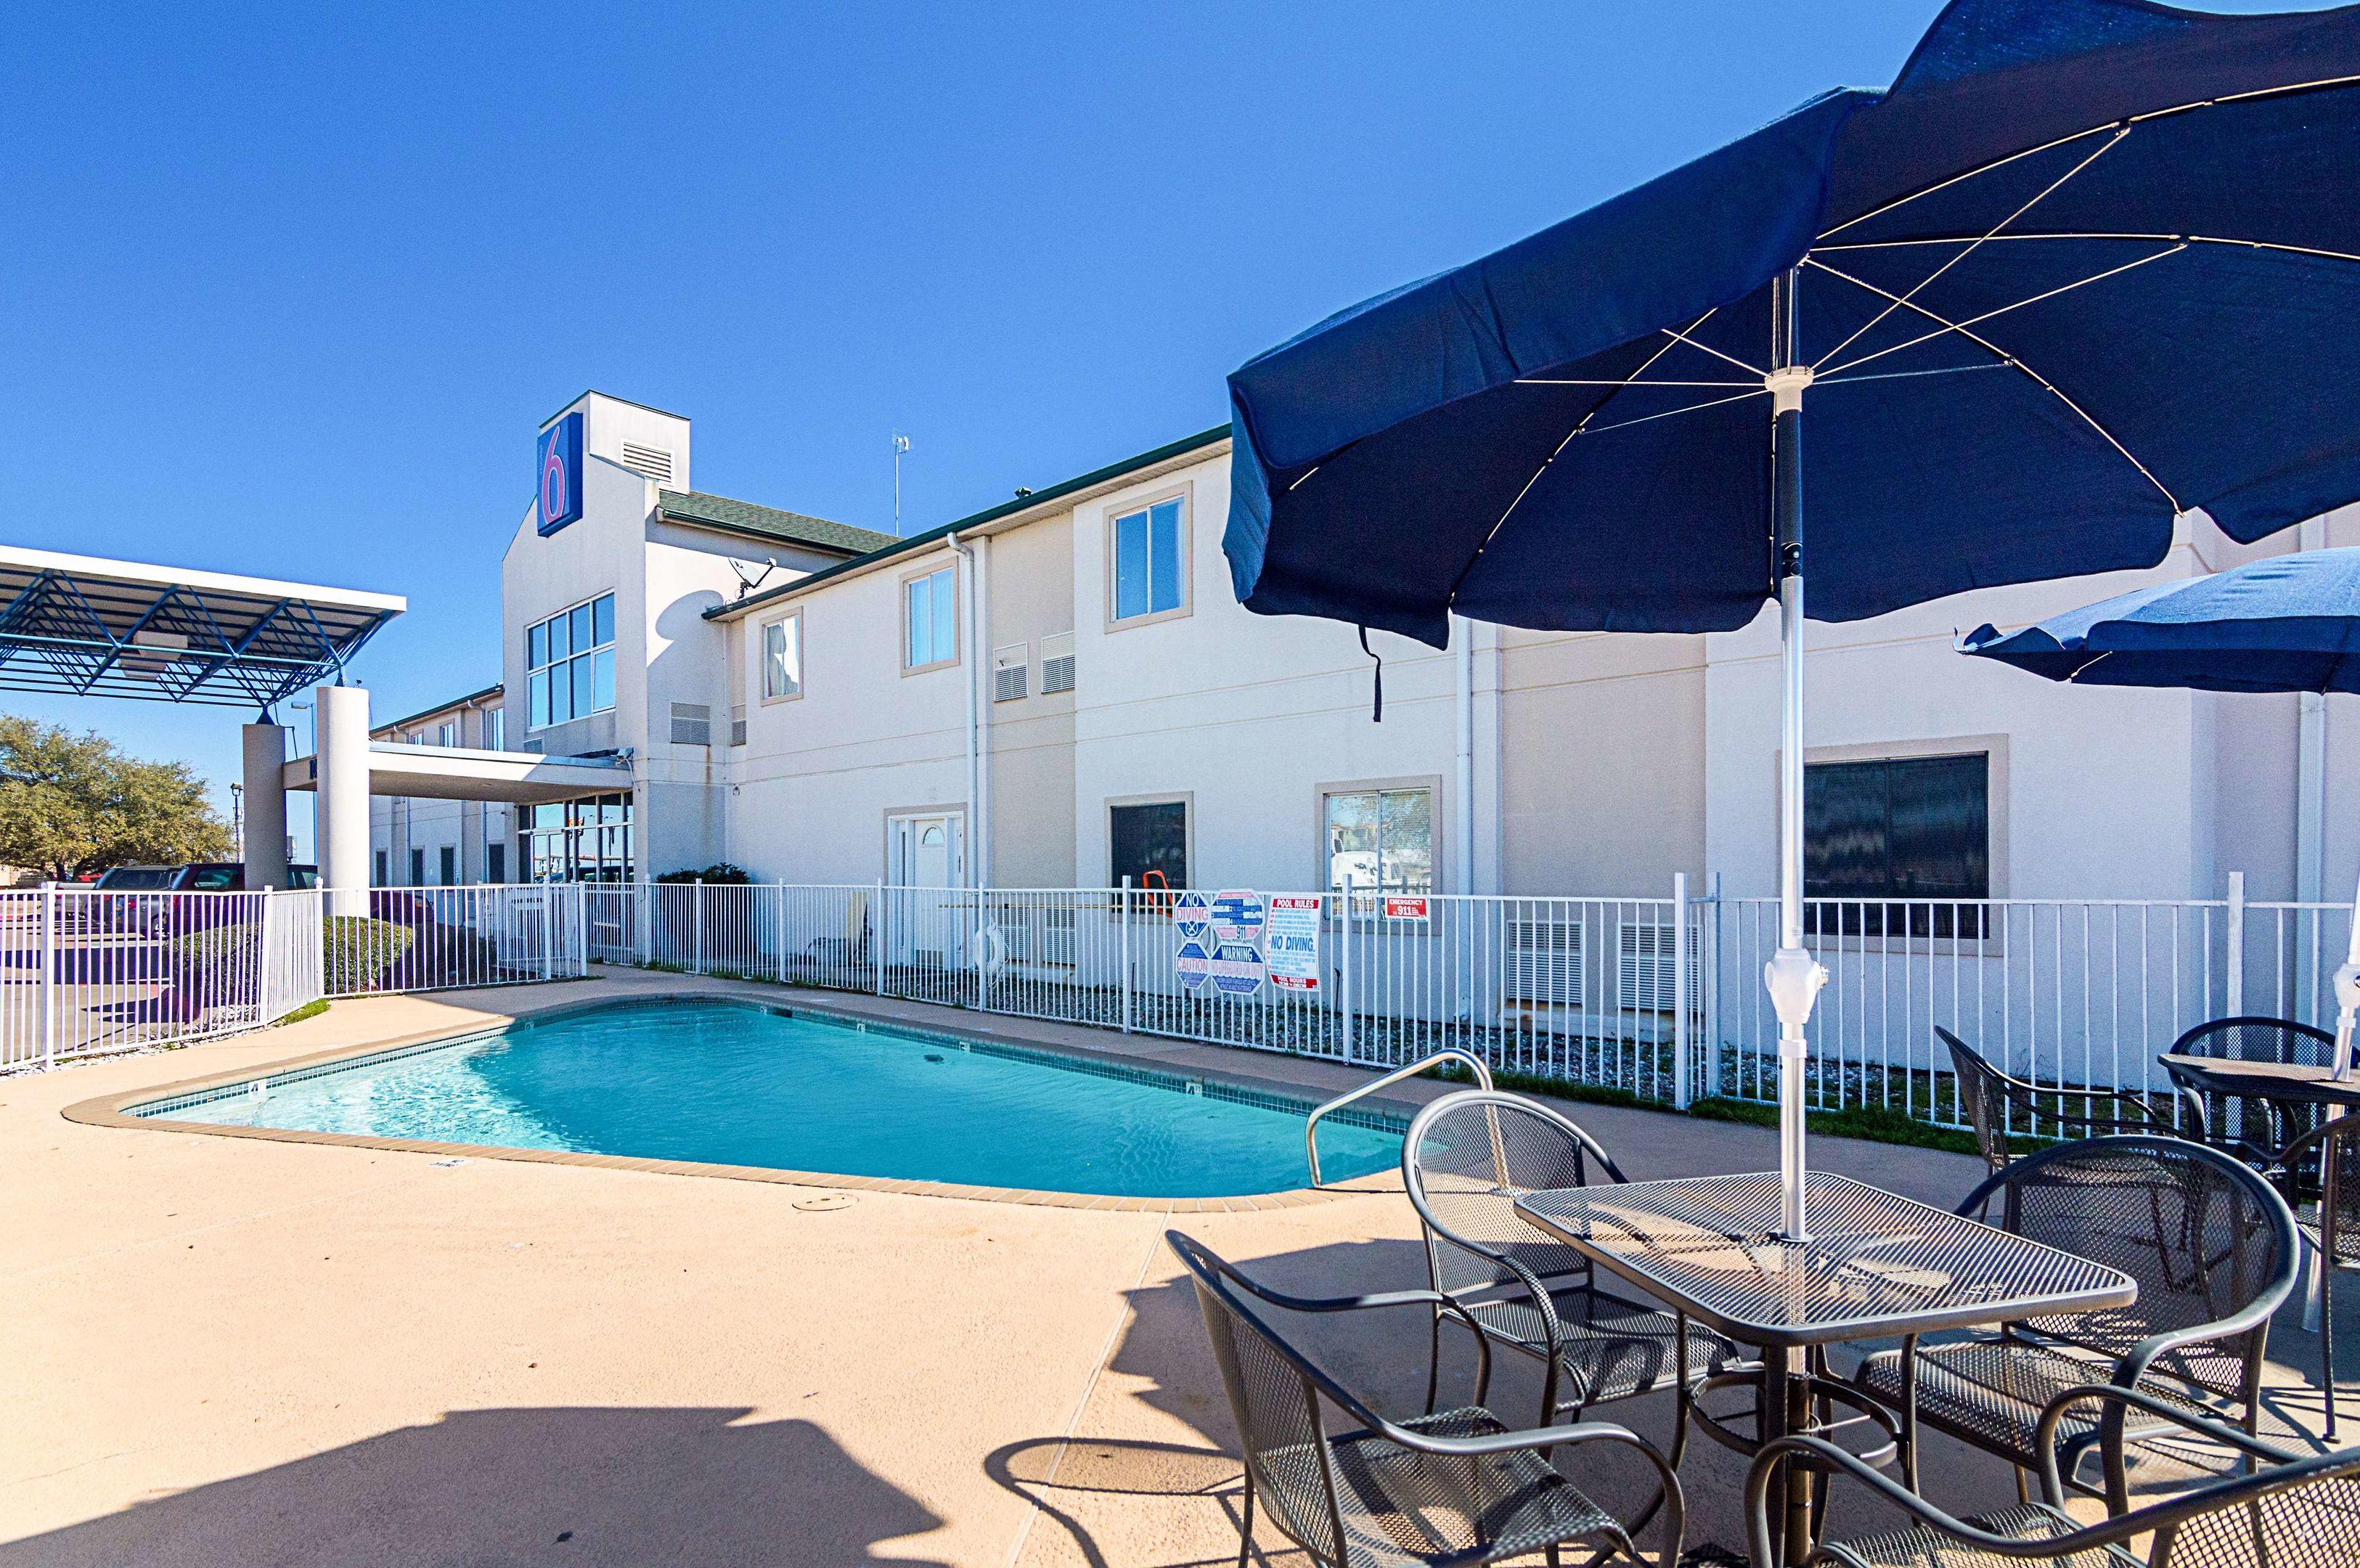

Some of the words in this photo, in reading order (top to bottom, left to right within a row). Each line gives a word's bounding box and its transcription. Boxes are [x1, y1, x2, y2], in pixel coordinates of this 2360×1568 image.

[542, 425, 565, 524] 6
[1185, 894, 1199, 907] NO
[1177, 907, 1209, 920] DIVING
[1397, 905, 1411, 915] 911
[1236, 926, 1246, 939] 911
[1271, 936, 1283, 950] NO
[1286, 936, 1315, 952] DIVING.
[1222, 946, 1252, 962] WARNING
[1177, 958, 1208, 971] CAUTION
